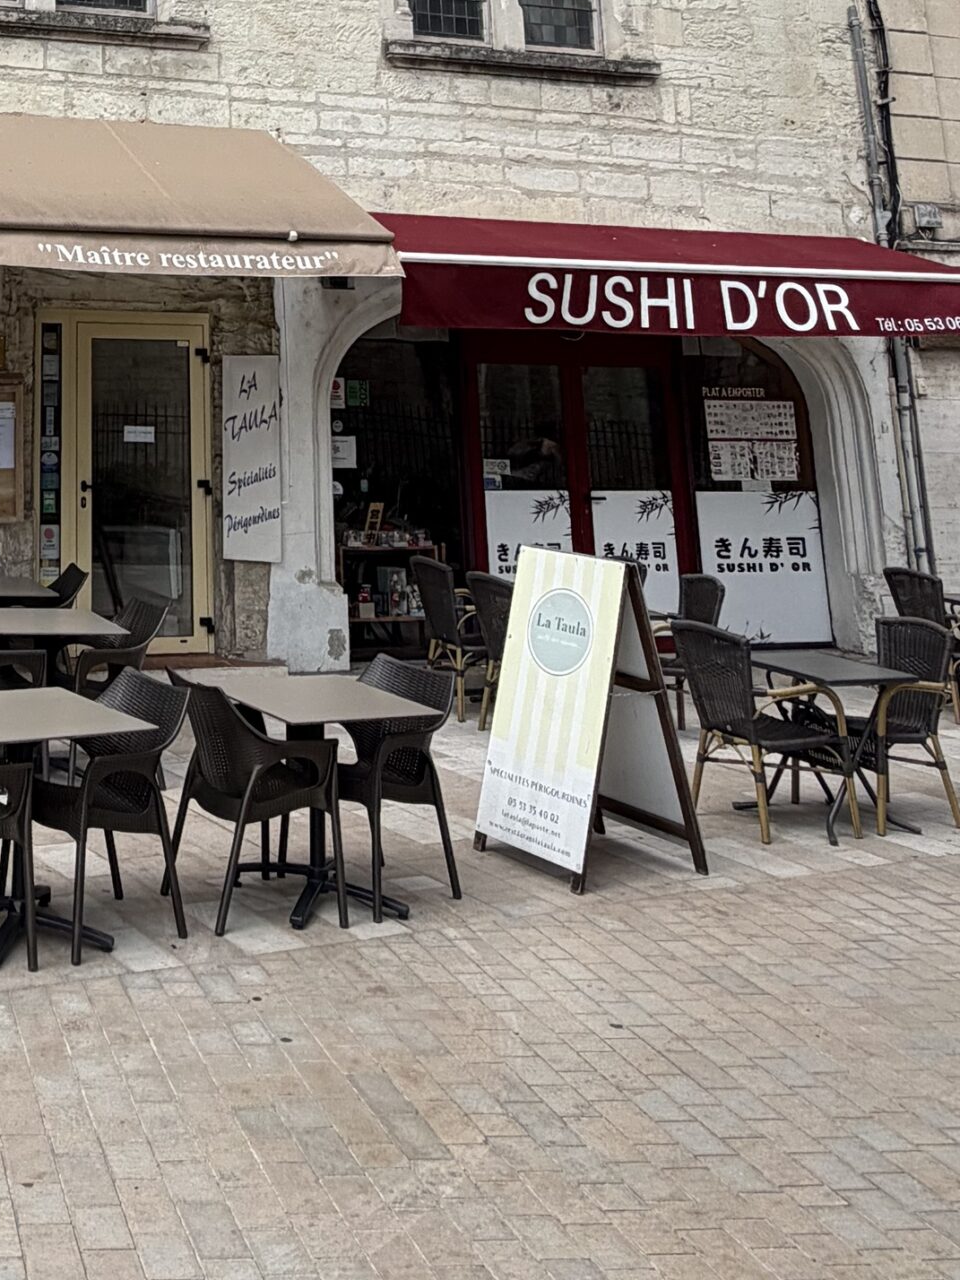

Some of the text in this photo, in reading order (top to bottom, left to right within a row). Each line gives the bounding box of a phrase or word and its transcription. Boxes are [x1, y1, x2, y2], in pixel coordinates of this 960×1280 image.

[524, 272, 861, 332] SUSHI D'OR
[905, 318, 924, 332] 05
[924, 318, 945, 331] 53
[238, 371, 258, 400] LA
[703, 387, 721, 397] PLAT
[728, 388, 765, 398] EMPORTER
[224, 401, 278, 441] TAULA
[227, 463, 276, 496] Spécialités
[224, 506, 280, 538] Périgourdines
[603, 542, 667, 560] きん寿司
[714, 536, 808, 560] きん寿司
[717, 563, 764, 573] SUSHI
[536, 612, 586, 637] La Taula
[507, 796, 517, 808] 05
[539, 809, 548, 820] 40
